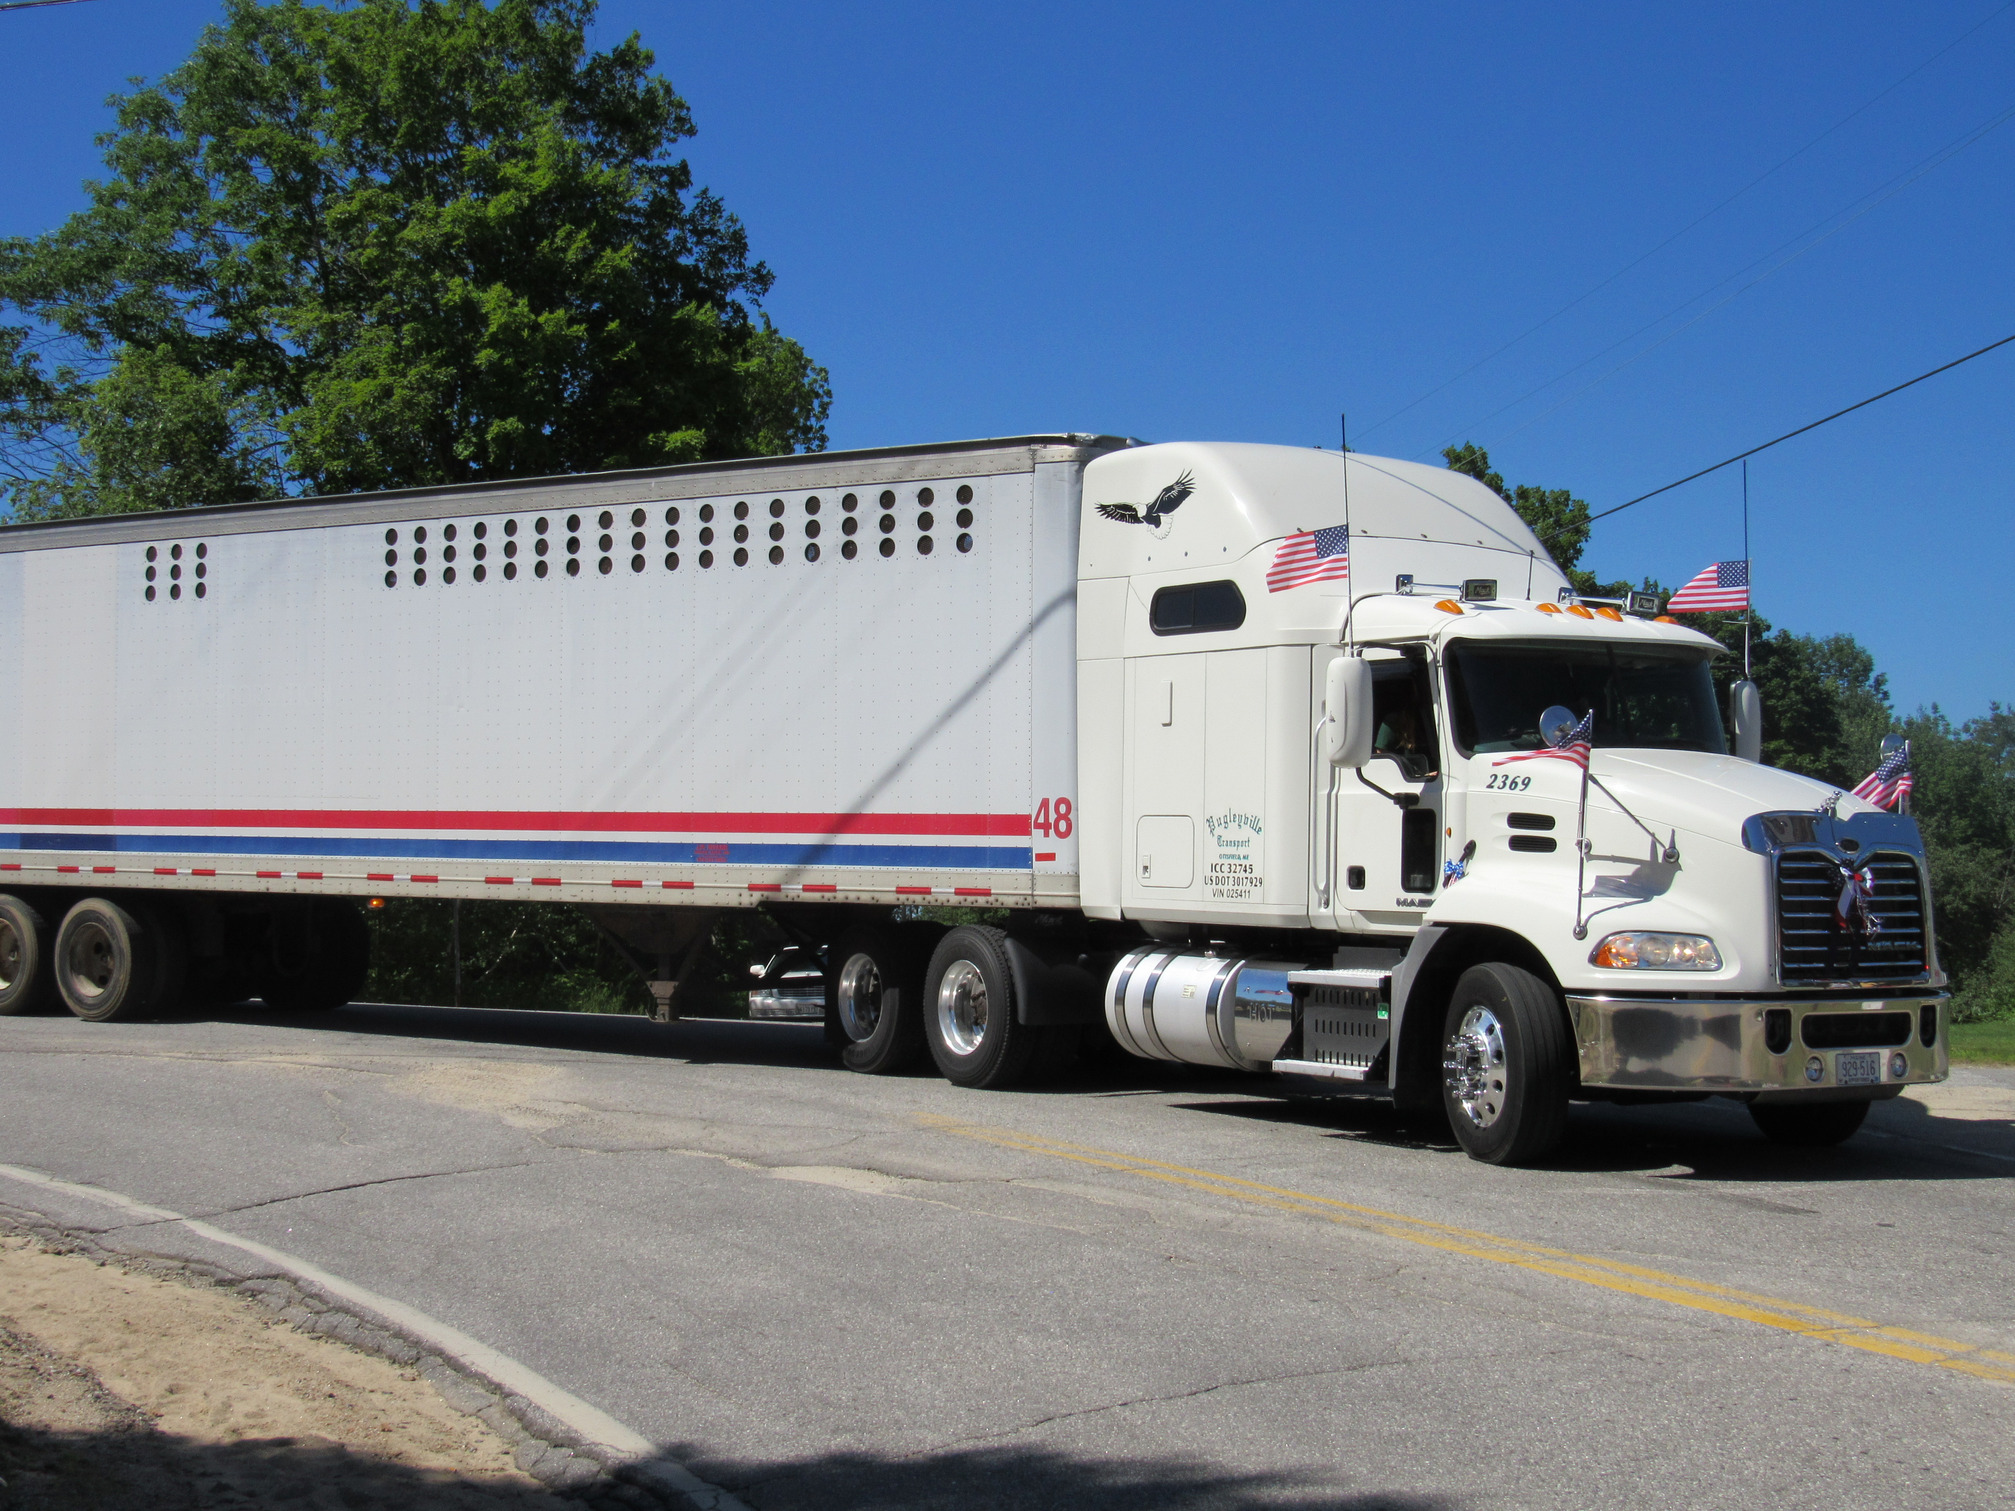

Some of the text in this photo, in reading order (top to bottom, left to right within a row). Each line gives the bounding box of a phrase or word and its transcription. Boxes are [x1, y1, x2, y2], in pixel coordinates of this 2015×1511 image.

[1485, 773, 1532, 792] 2369
[1033, 796, 1073, 840] 48
[1216, 834, 1250, 851] Transport
[1210, 862, 1254, 875] ICC 32745
[1232, 876, 1263, 888] 3017929
[1212, 888, 1251, 900] VIN 025411
[1248, 1002, 1276, 1023] HOT
